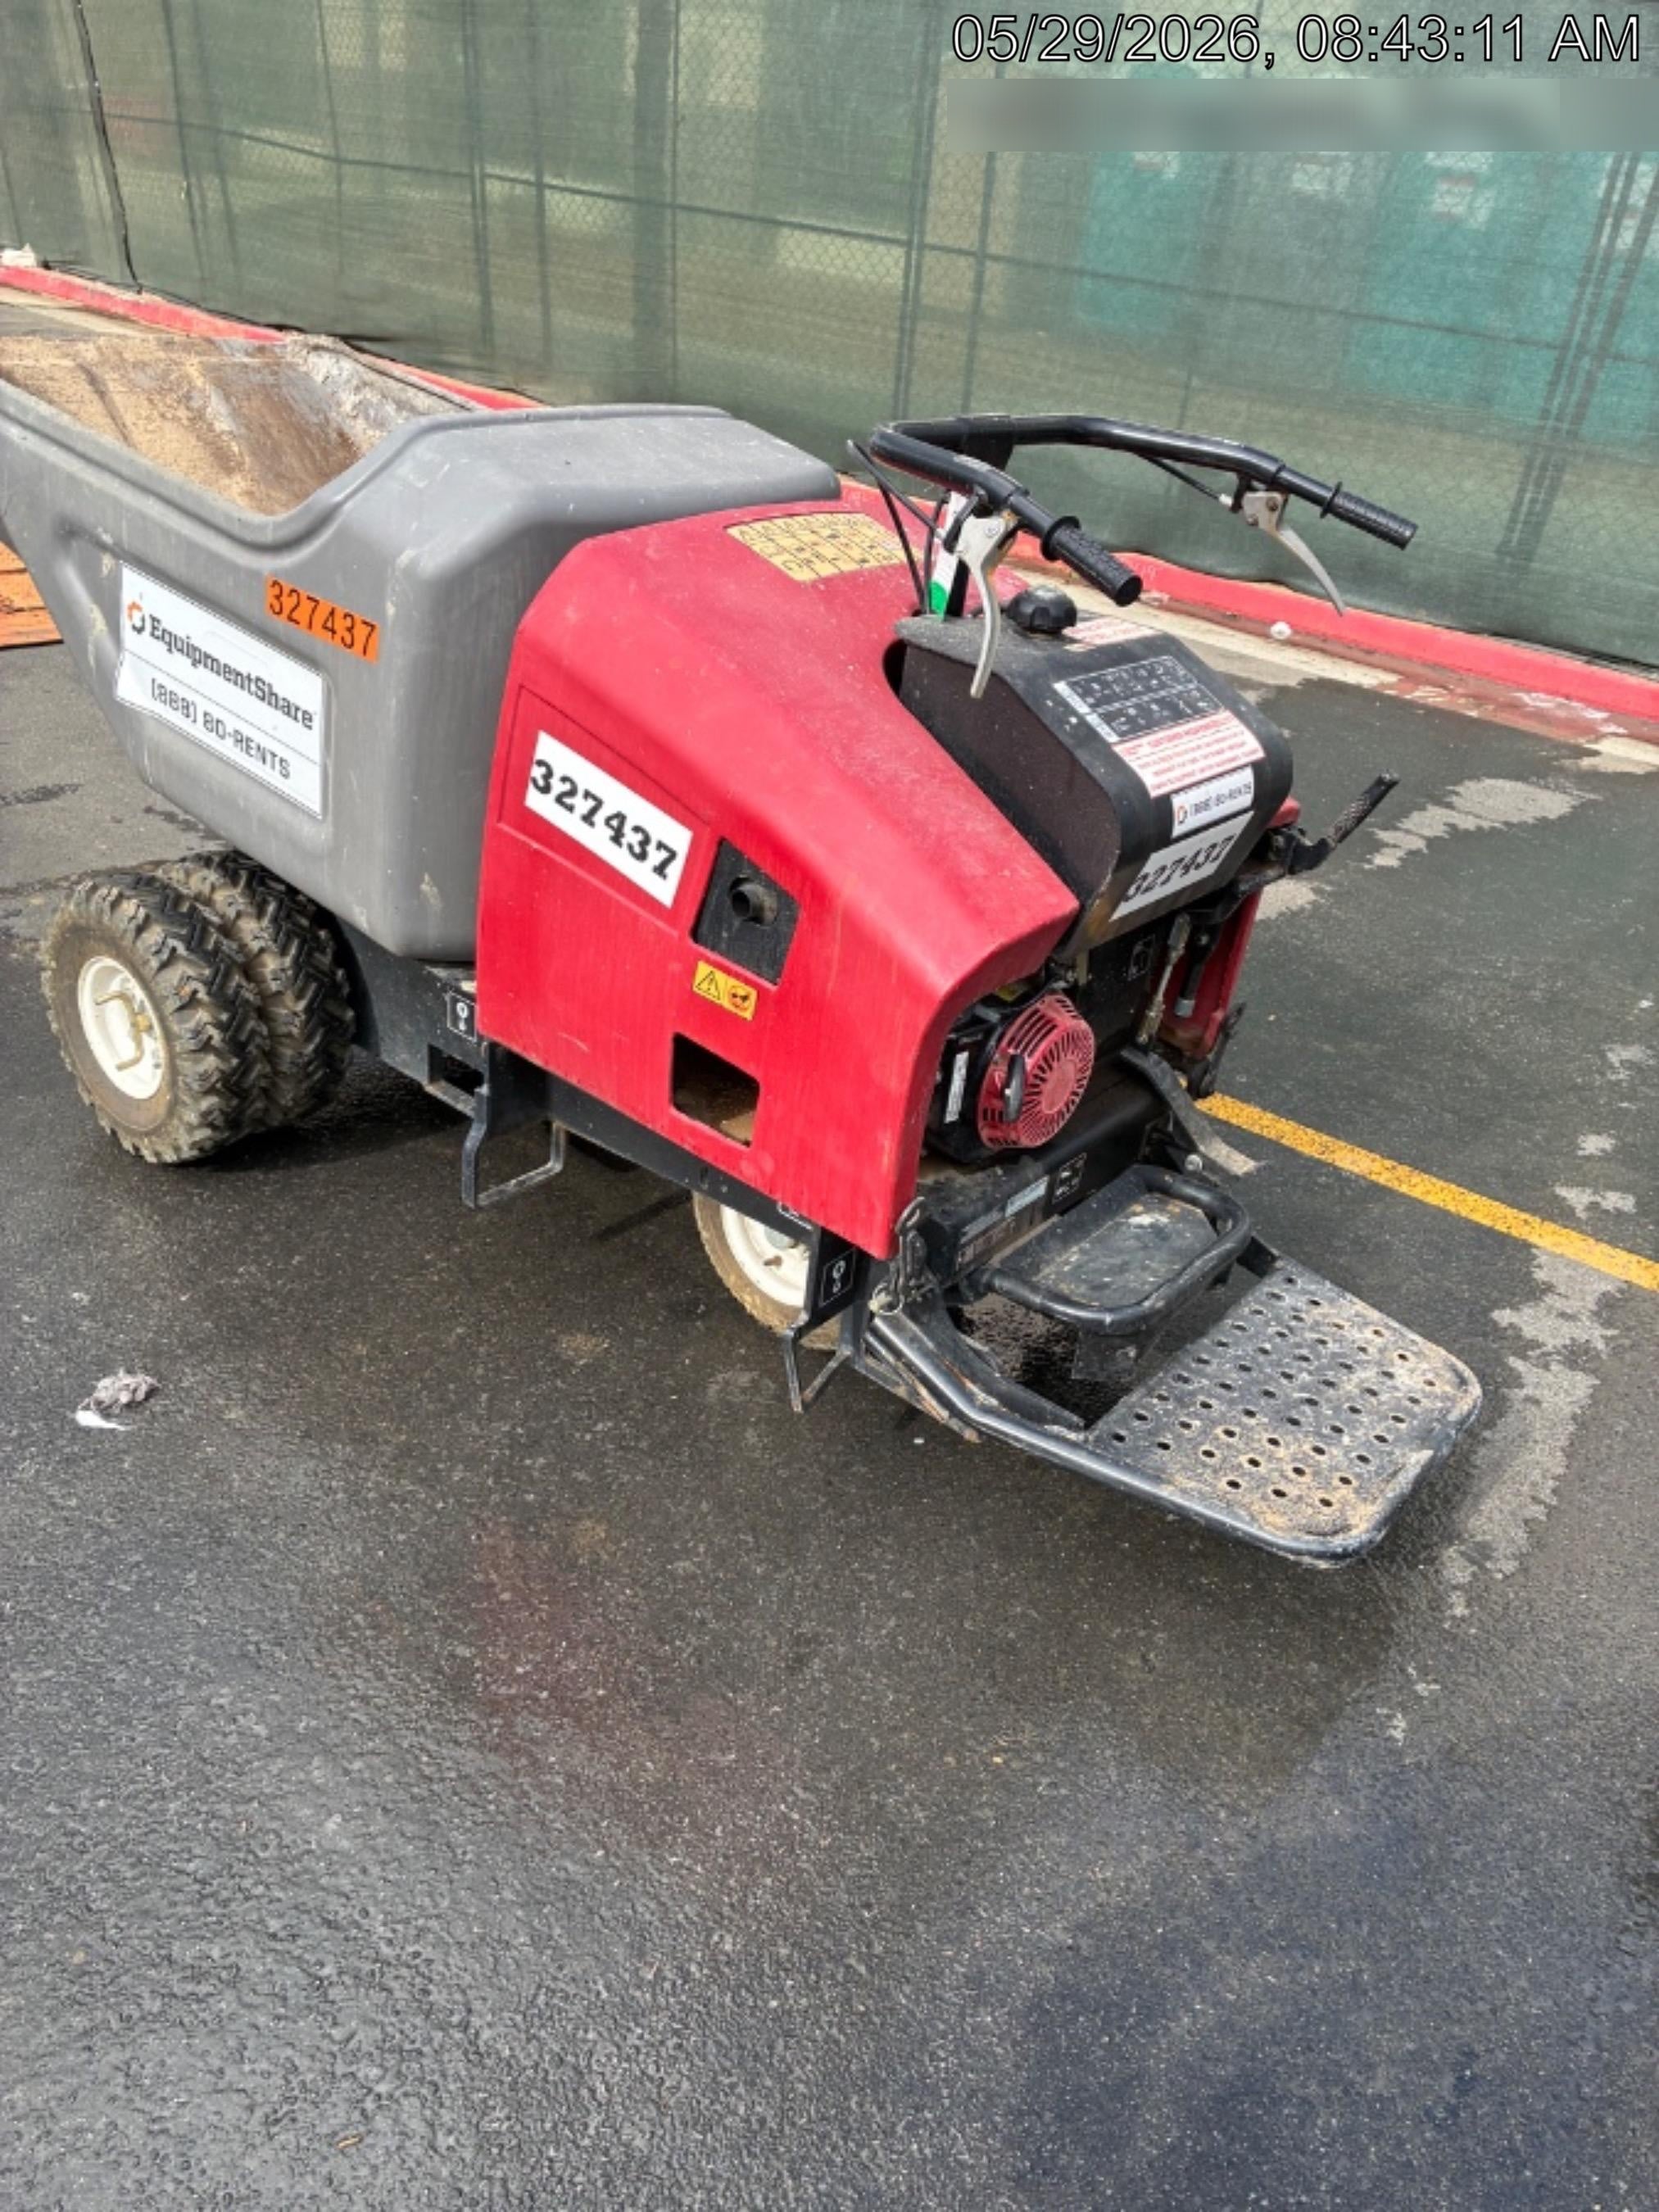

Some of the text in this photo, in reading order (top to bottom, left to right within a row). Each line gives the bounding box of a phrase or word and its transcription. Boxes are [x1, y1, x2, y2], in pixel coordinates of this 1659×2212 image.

[148, 613, 314, 731] EquipmentShare
[269, 578, 377, 657] 327437
[530, 758, 678, 882] 327437
